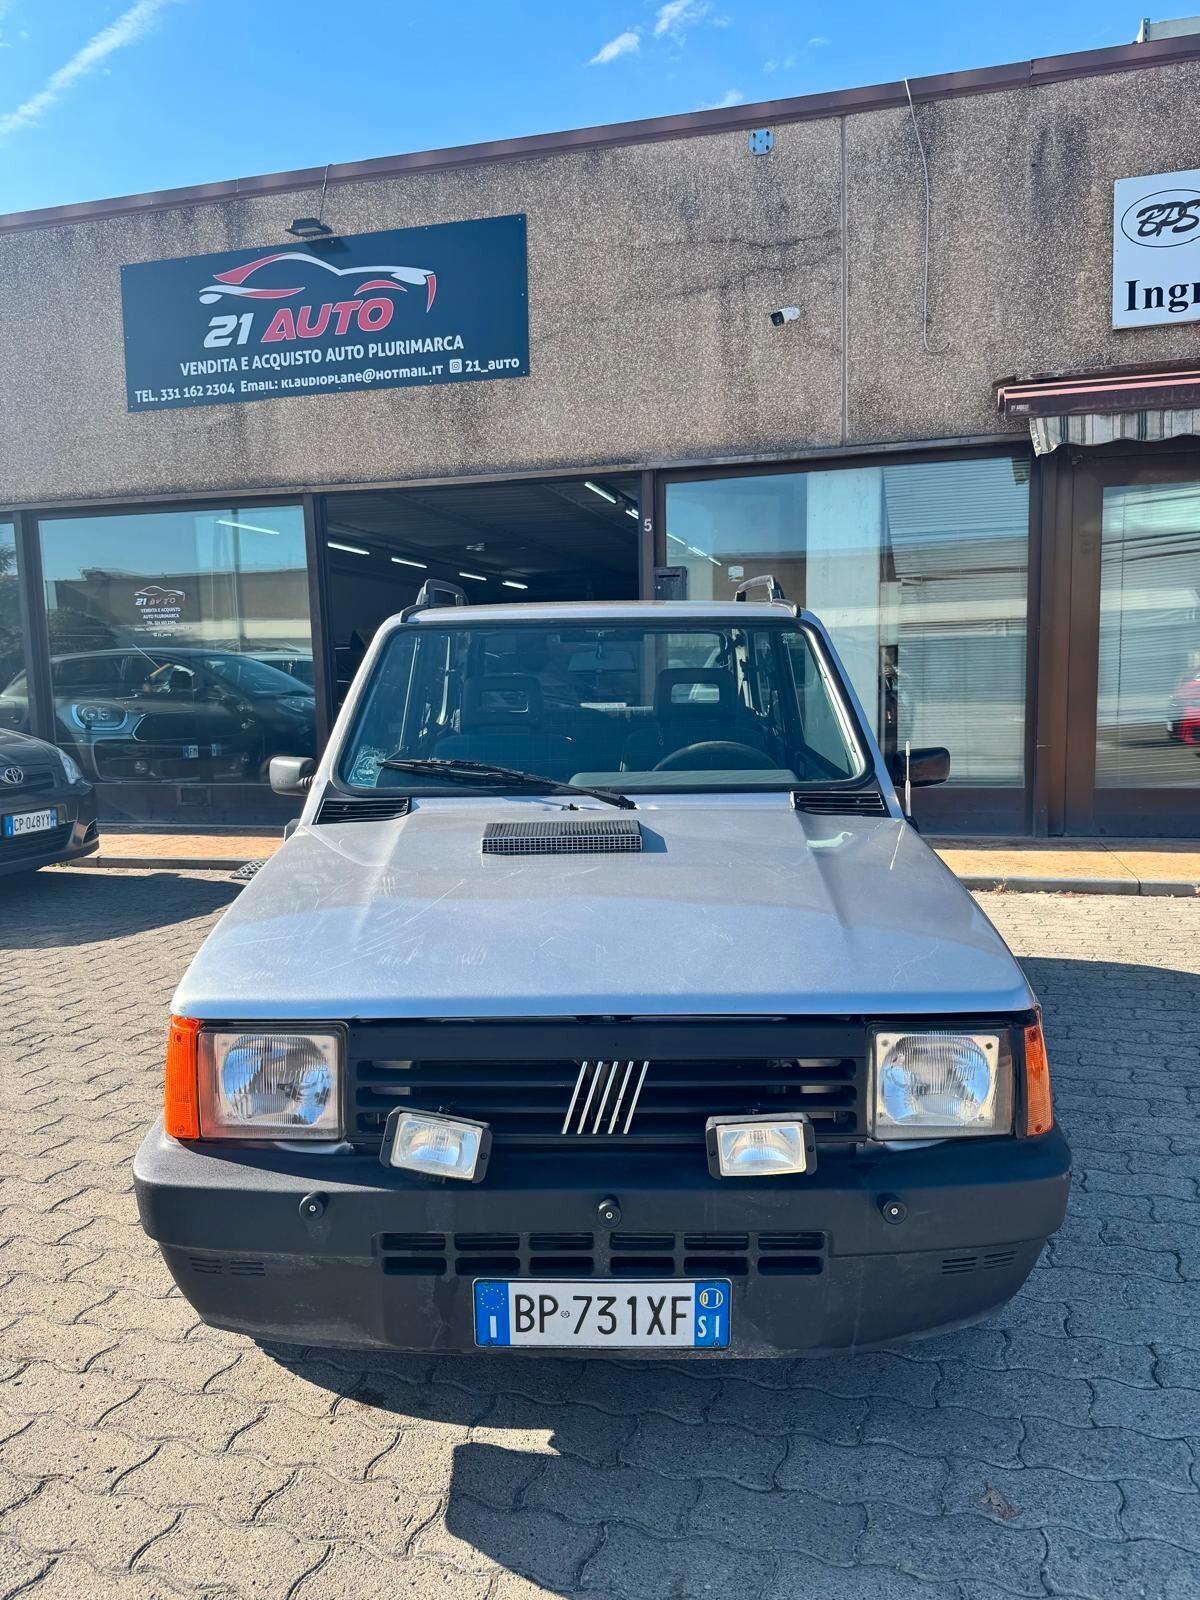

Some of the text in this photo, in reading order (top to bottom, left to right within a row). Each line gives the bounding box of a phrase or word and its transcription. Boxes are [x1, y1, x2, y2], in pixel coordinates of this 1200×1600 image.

[203, 297, 394, 349] 21 AUTO
[180, 335, 464, 376] VENDITA E ACQUISTO AUTO PLURIMARCA
[135, 389, 159, 403] TEL.
[160, 387, 181, 401] 331
[183, 385, 204, 398] 162
[206, 382, 235, 396] 2304
[644, 518, 652, 532] 5
[515, 1294, 559, 1333] BP
[572, 1295, 692, 1335] 731XF
